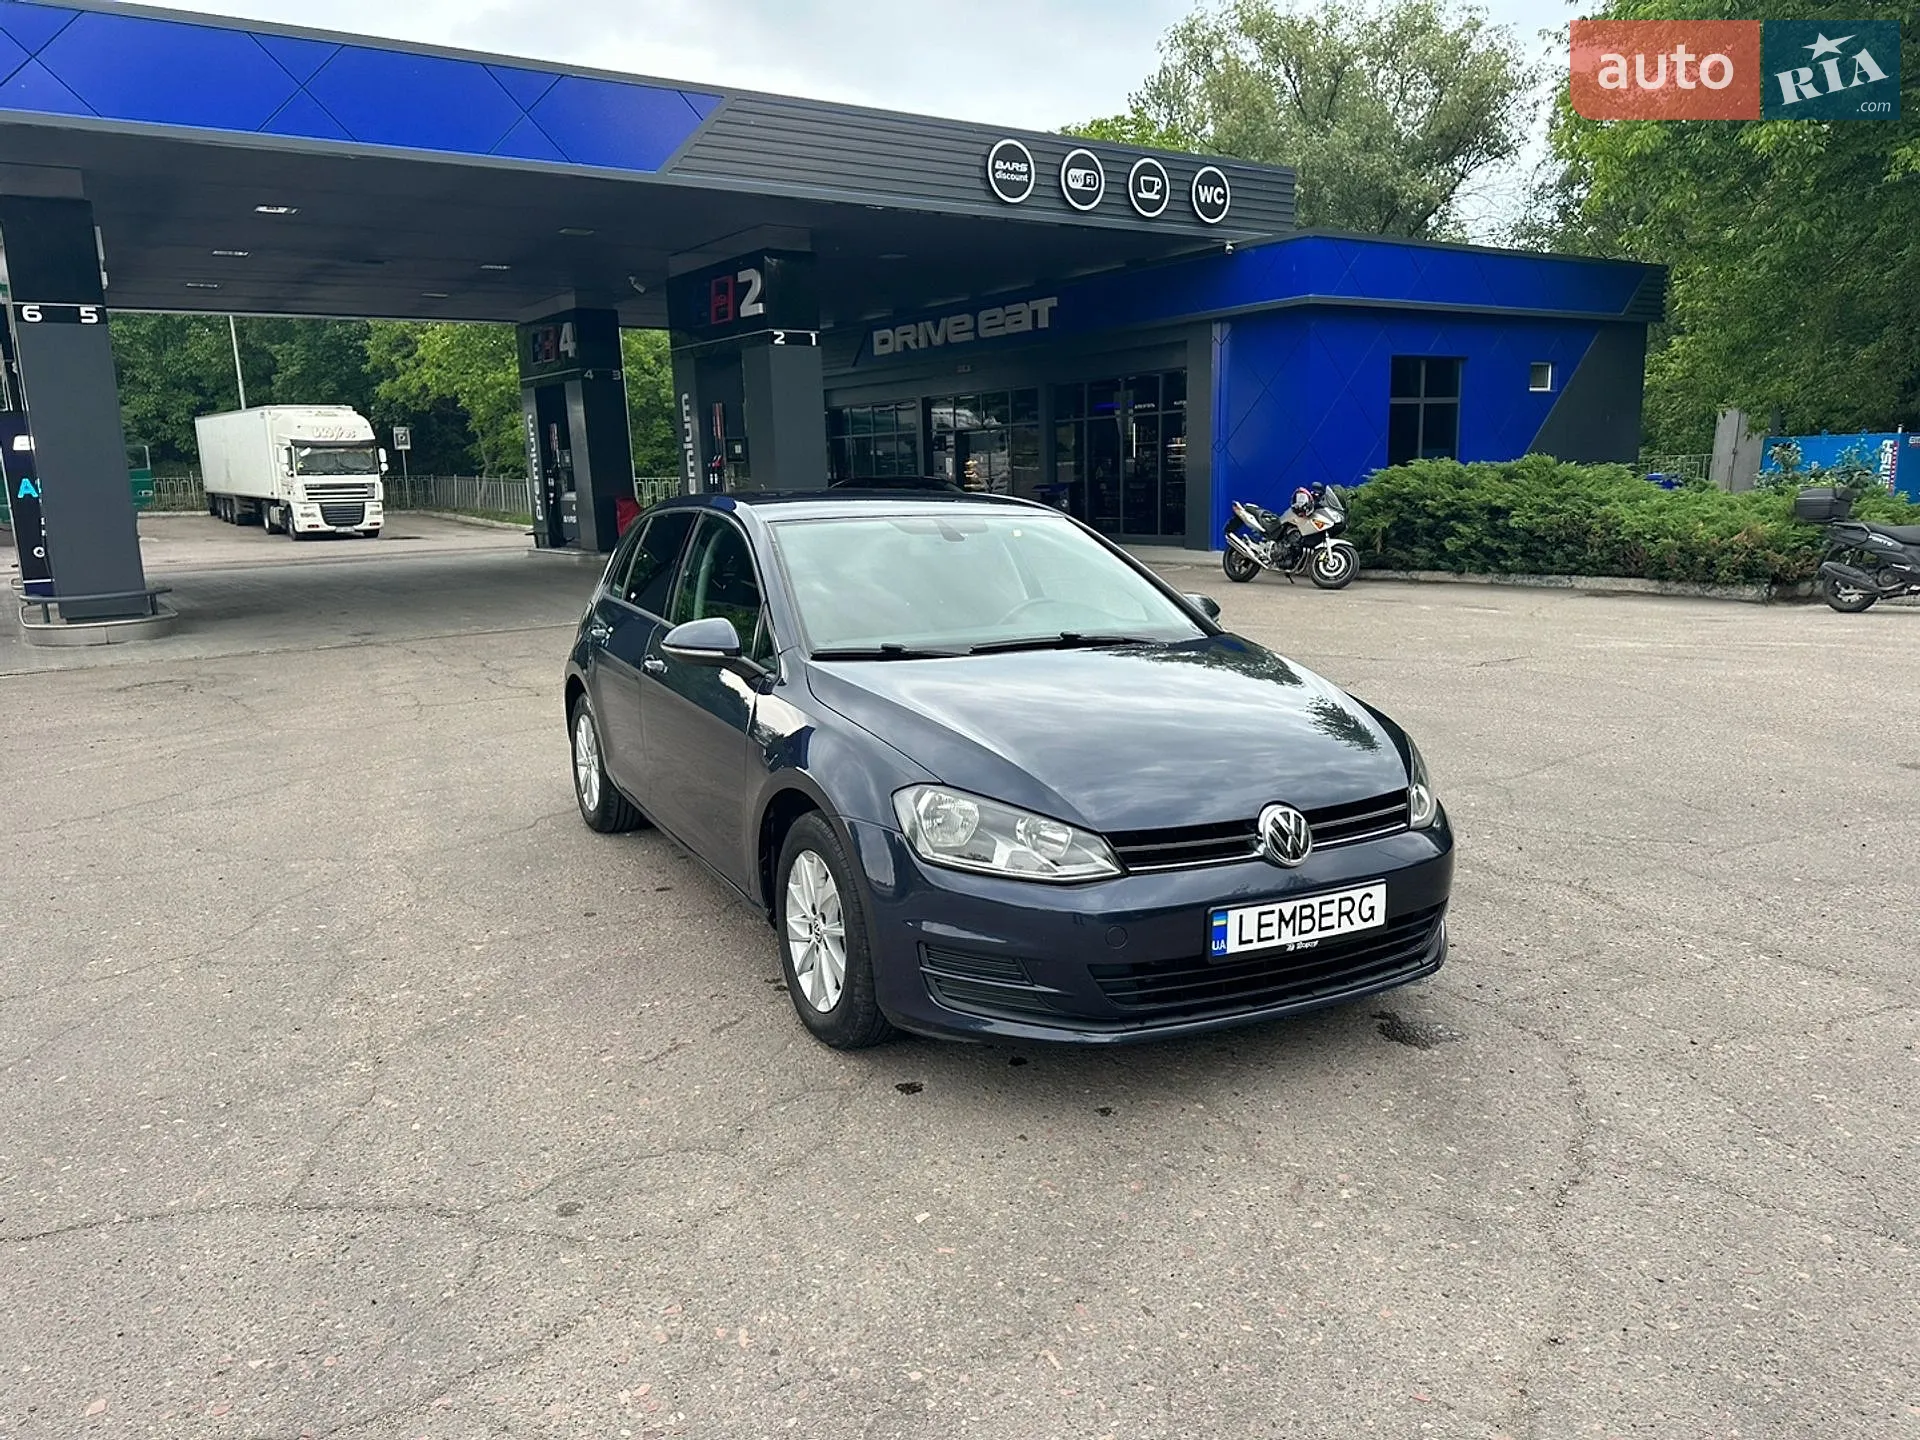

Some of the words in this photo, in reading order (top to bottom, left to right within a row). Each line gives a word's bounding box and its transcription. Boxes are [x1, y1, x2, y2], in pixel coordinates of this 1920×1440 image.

[995, 160, 1028, 172] BARS
[995, 170, 1028, 182] discount
[1199, 184, 1225, 205] WC
[737, 268, 766, 318] 2
[22, 305, 43, 323] 6
[79, 306, 99, 324] 5
[559, 322, 577, 358] 4
[773, 331, 785, 345] 2
[809, 332, 817, 346] 1
[584, 369, 594, 379] 4
[612, 369, 621, 381] 3
[681, 392, 697, 495] emium
[528, 414, 543, 520] premium
[1238, 892, 1375, 945] LEMBERG
[1212, 939, 1227, 951] UA
